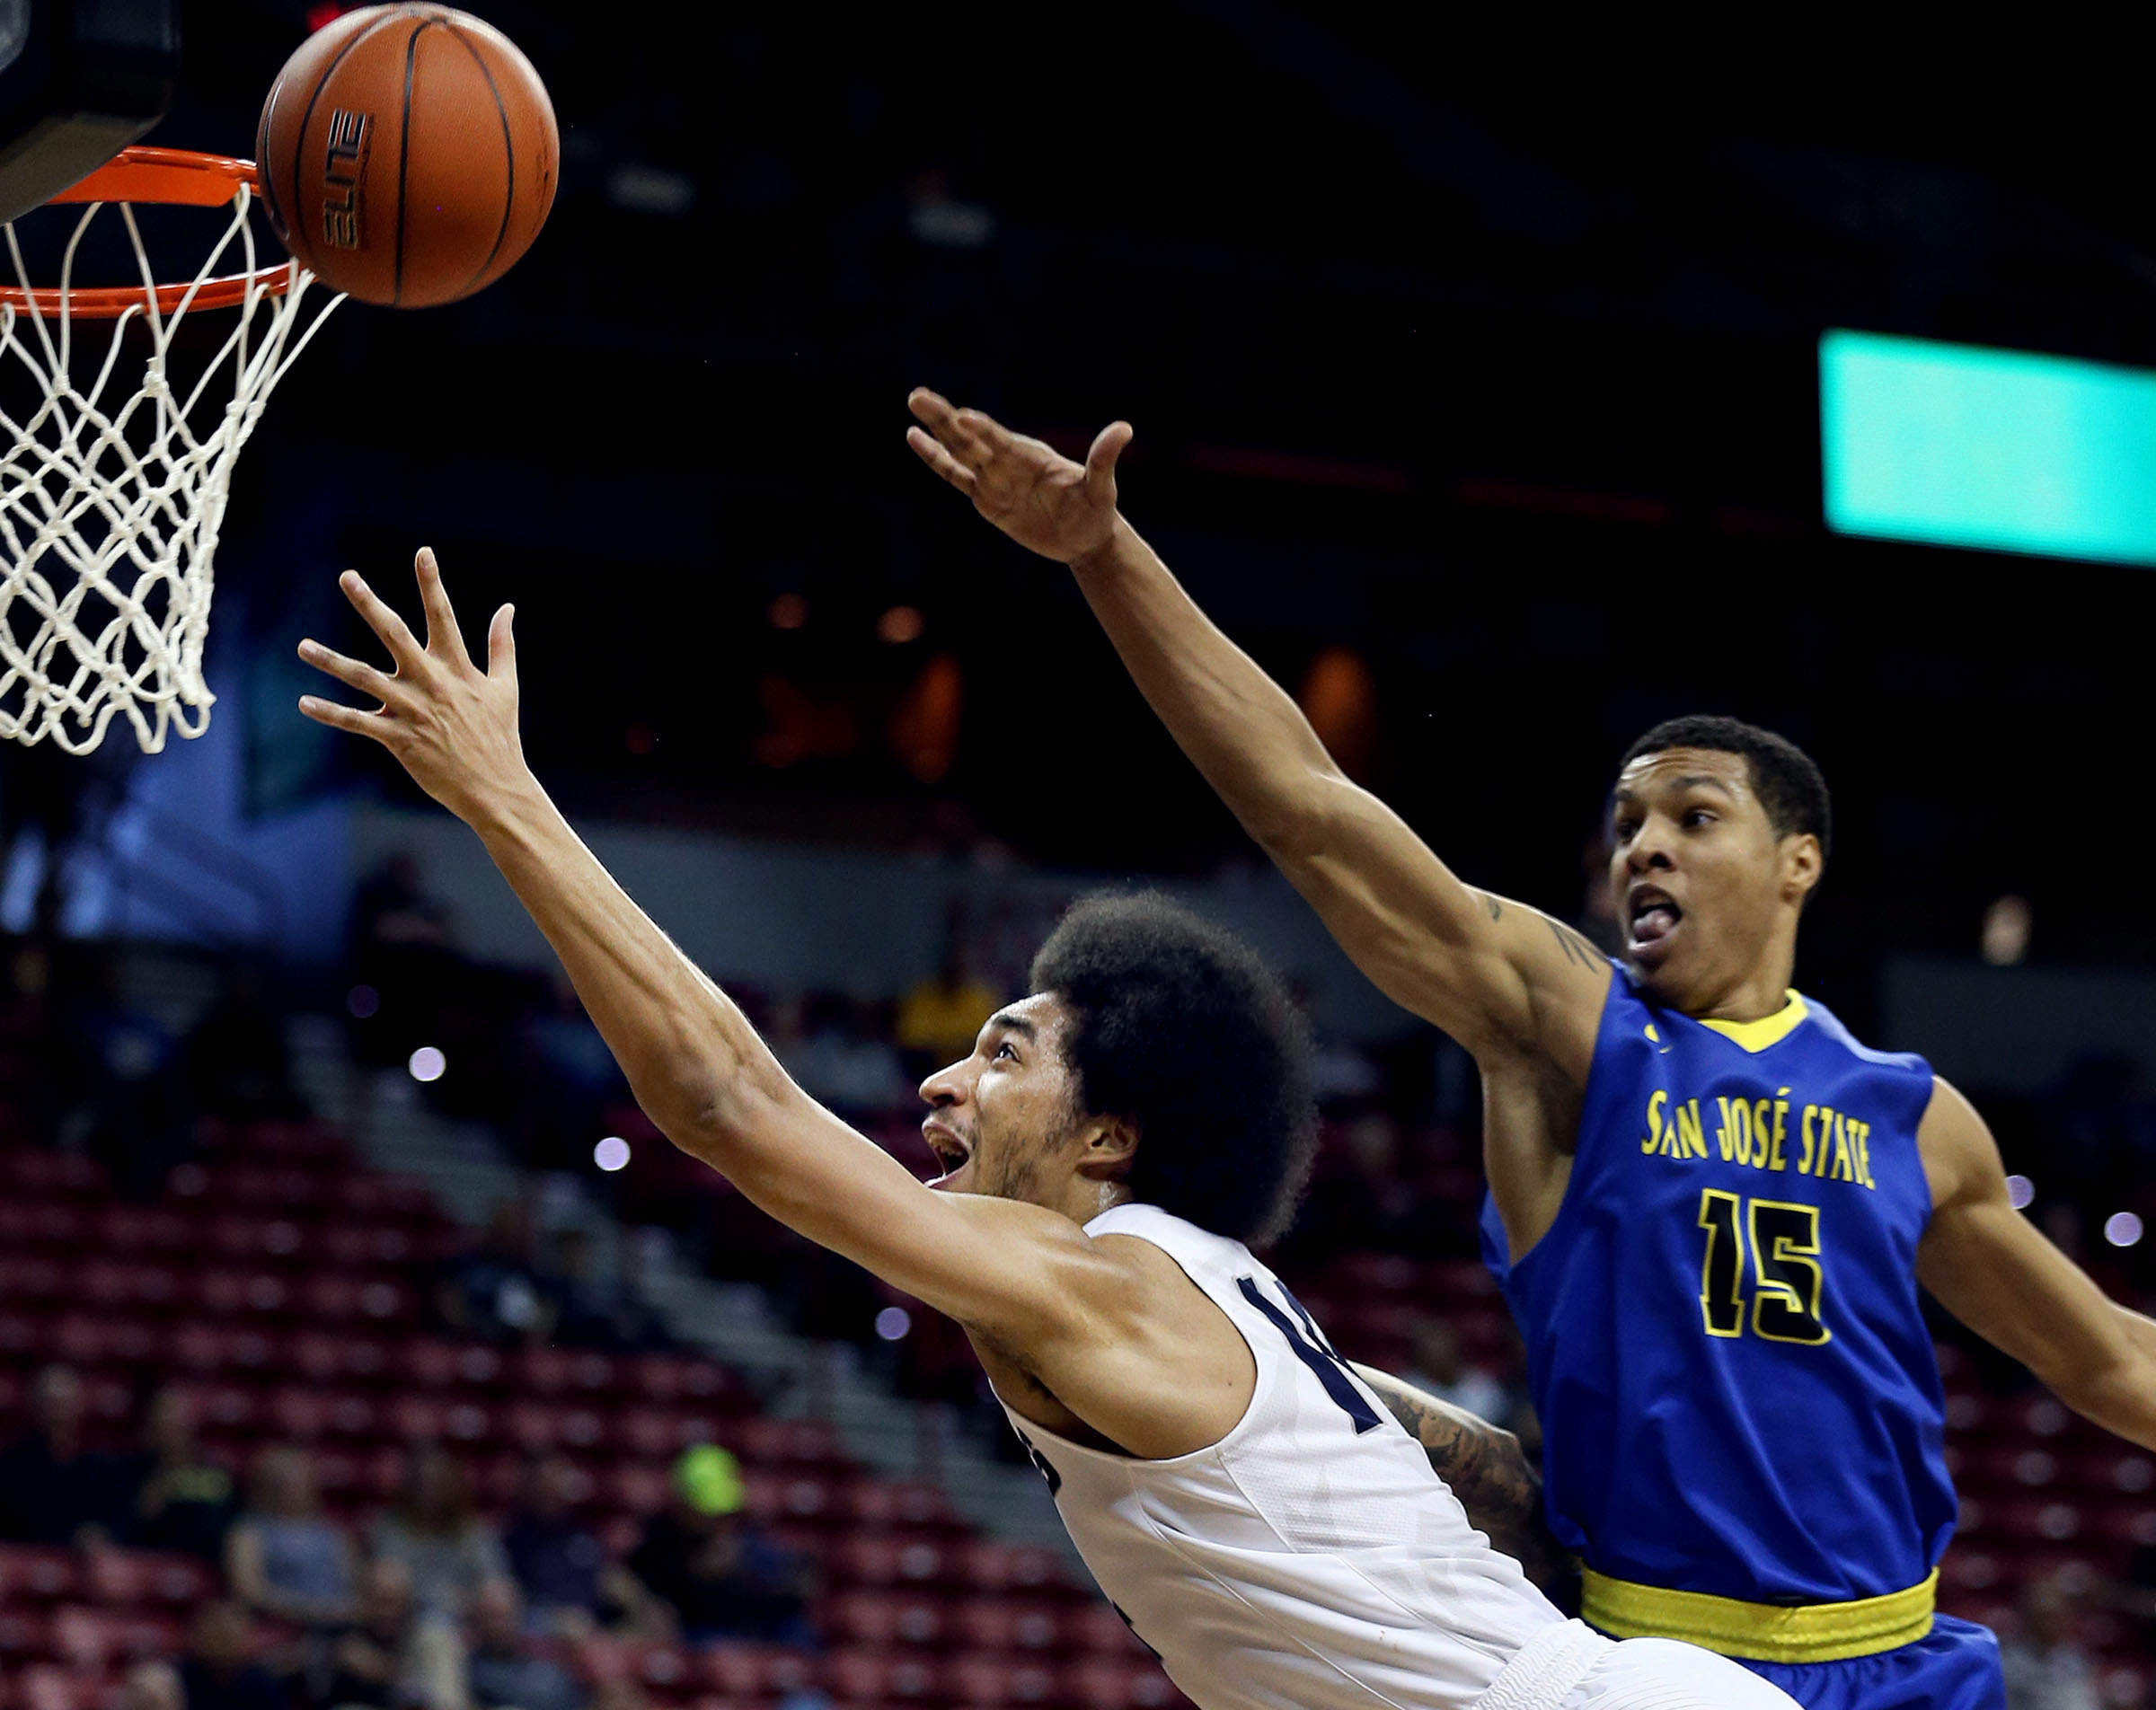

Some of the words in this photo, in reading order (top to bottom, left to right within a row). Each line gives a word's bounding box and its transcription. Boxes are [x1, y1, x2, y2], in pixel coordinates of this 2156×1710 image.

[323, 109, 365, 249] ELITE
[1642, 1090, 1708, 1159] SAN
[1717, 1087, 1791, 1171] JOSÉ
[1798, 1106, 1875, 1190] STATE
[1698, 1188, 1831, 1344] 15
